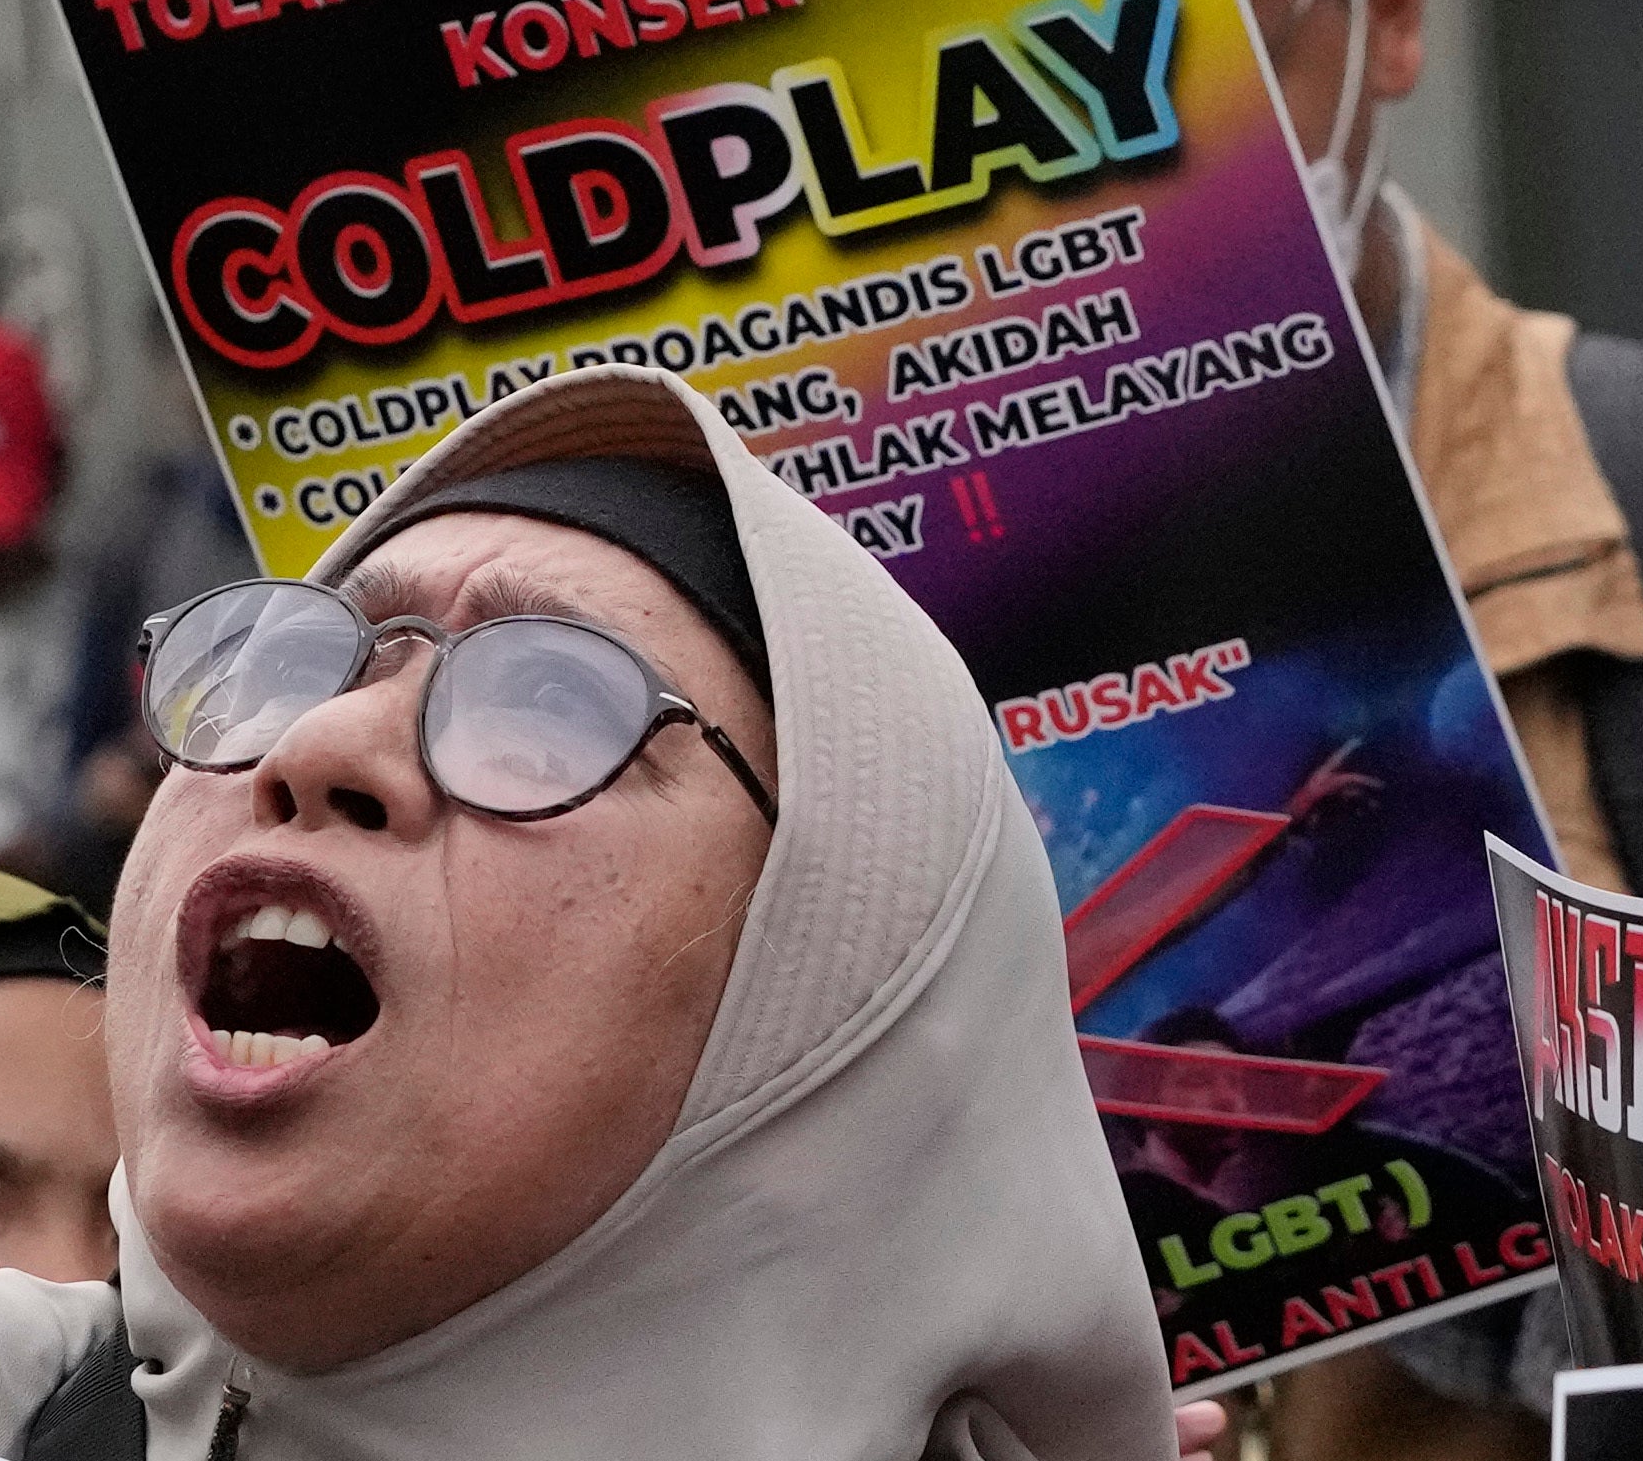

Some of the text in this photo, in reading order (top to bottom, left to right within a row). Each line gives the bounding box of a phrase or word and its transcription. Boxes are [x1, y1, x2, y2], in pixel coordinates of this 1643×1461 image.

[975, 205, 1145, 299] LGBT
[887, 288, 1139, 403] AKIDAH
[967, 311, 1335, 458] MELAYANG
[1280, 1254, 1445, 1347] ANTI
